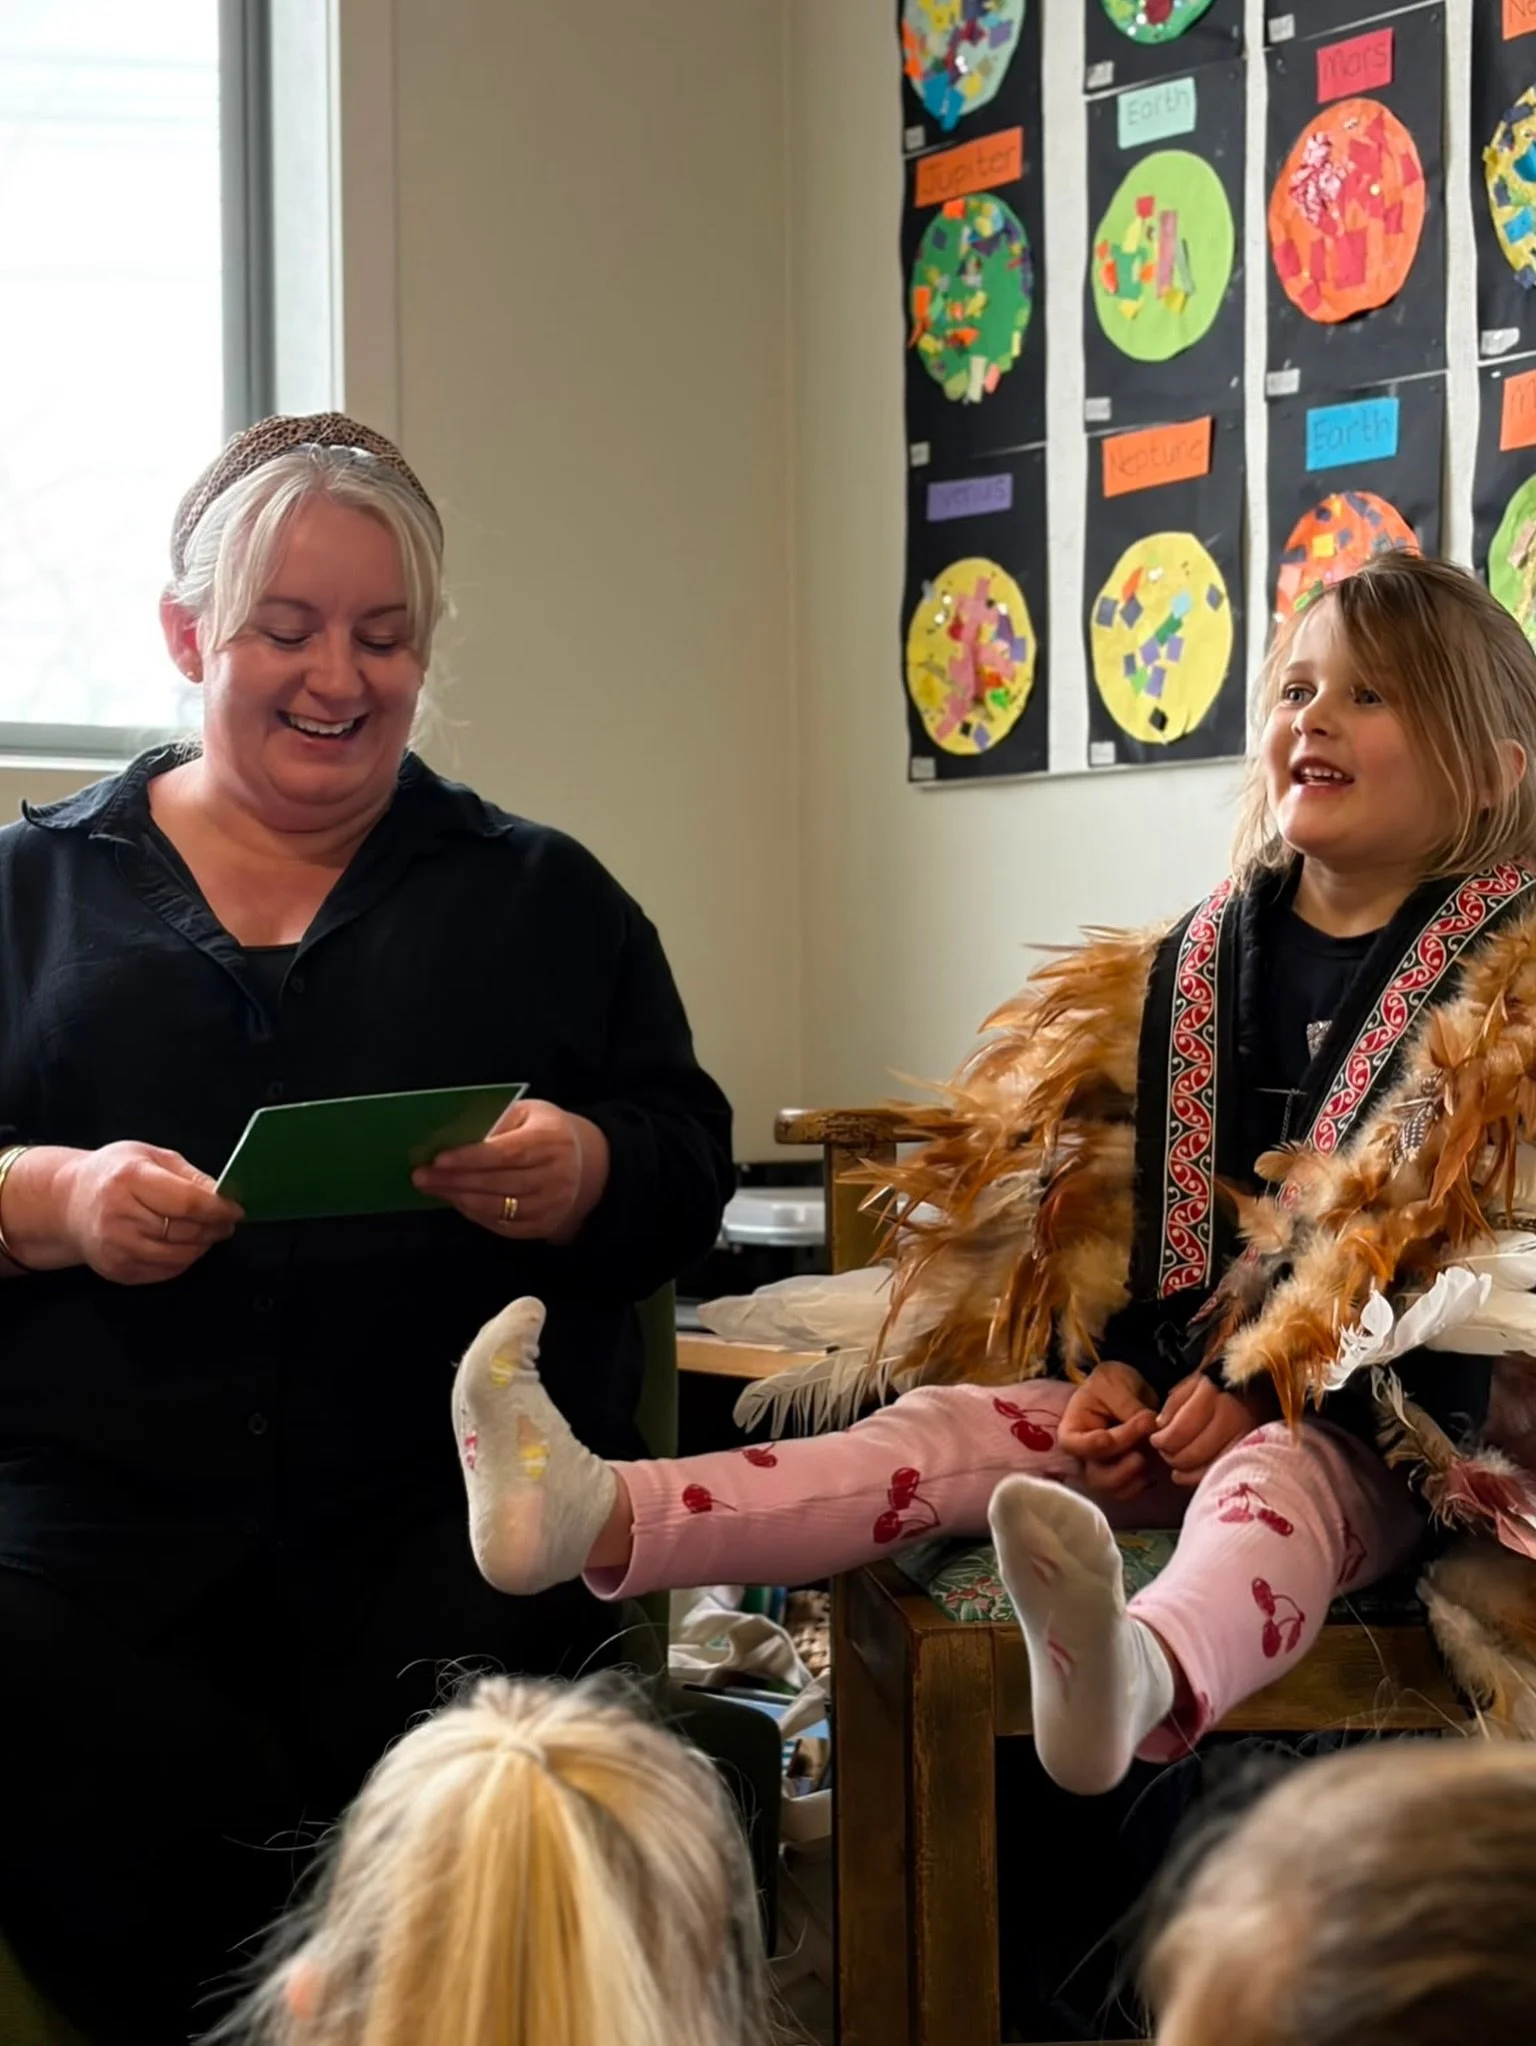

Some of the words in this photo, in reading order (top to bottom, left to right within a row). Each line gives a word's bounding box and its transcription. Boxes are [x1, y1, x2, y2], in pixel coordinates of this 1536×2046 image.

[1127, 86, 1192, 126] Earth
[921, 144, 1018, 196] Jupiter
[1313, 408, 1392, 452] Earth
